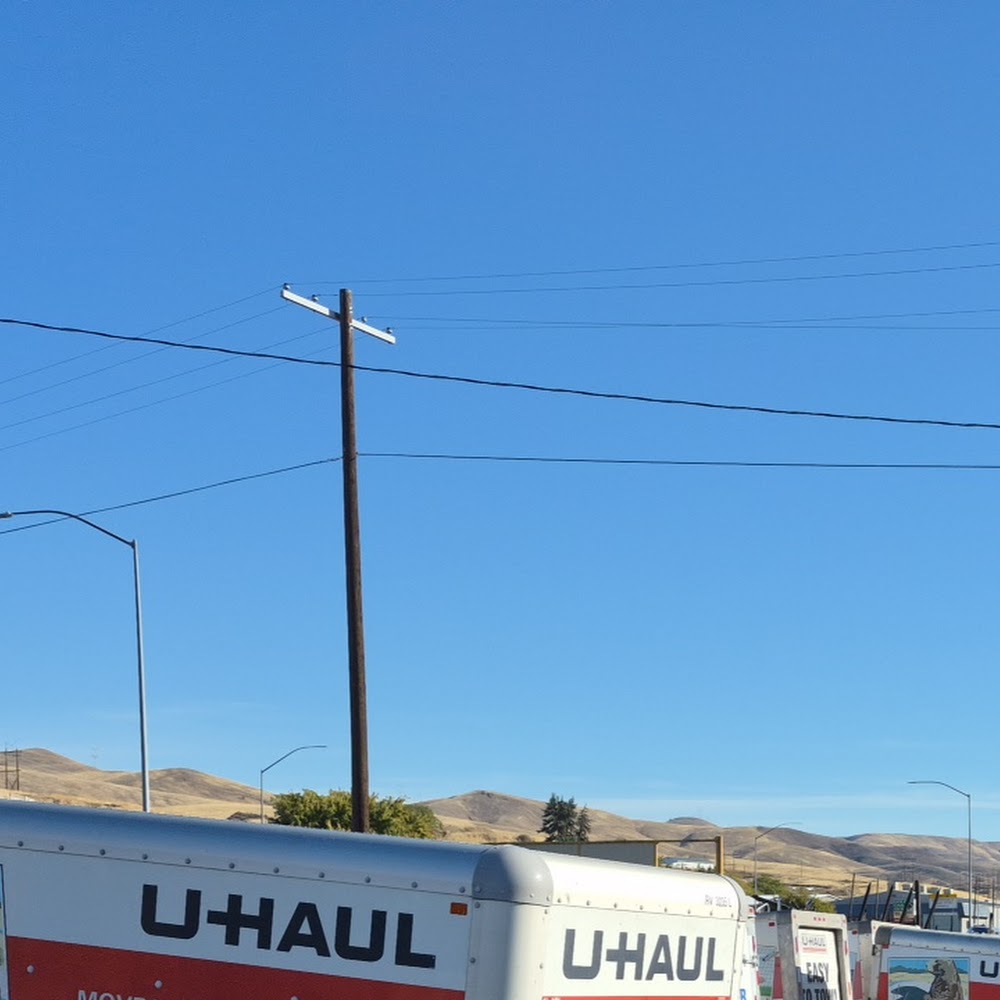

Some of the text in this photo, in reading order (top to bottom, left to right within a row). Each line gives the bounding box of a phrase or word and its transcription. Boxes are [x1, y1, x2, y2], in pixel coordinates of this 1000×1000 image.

[140, 883, 436, 969] U-HAUL
[562, 928, 724, 982] U-HAUL
[806, 962, 829, 983] EASY
